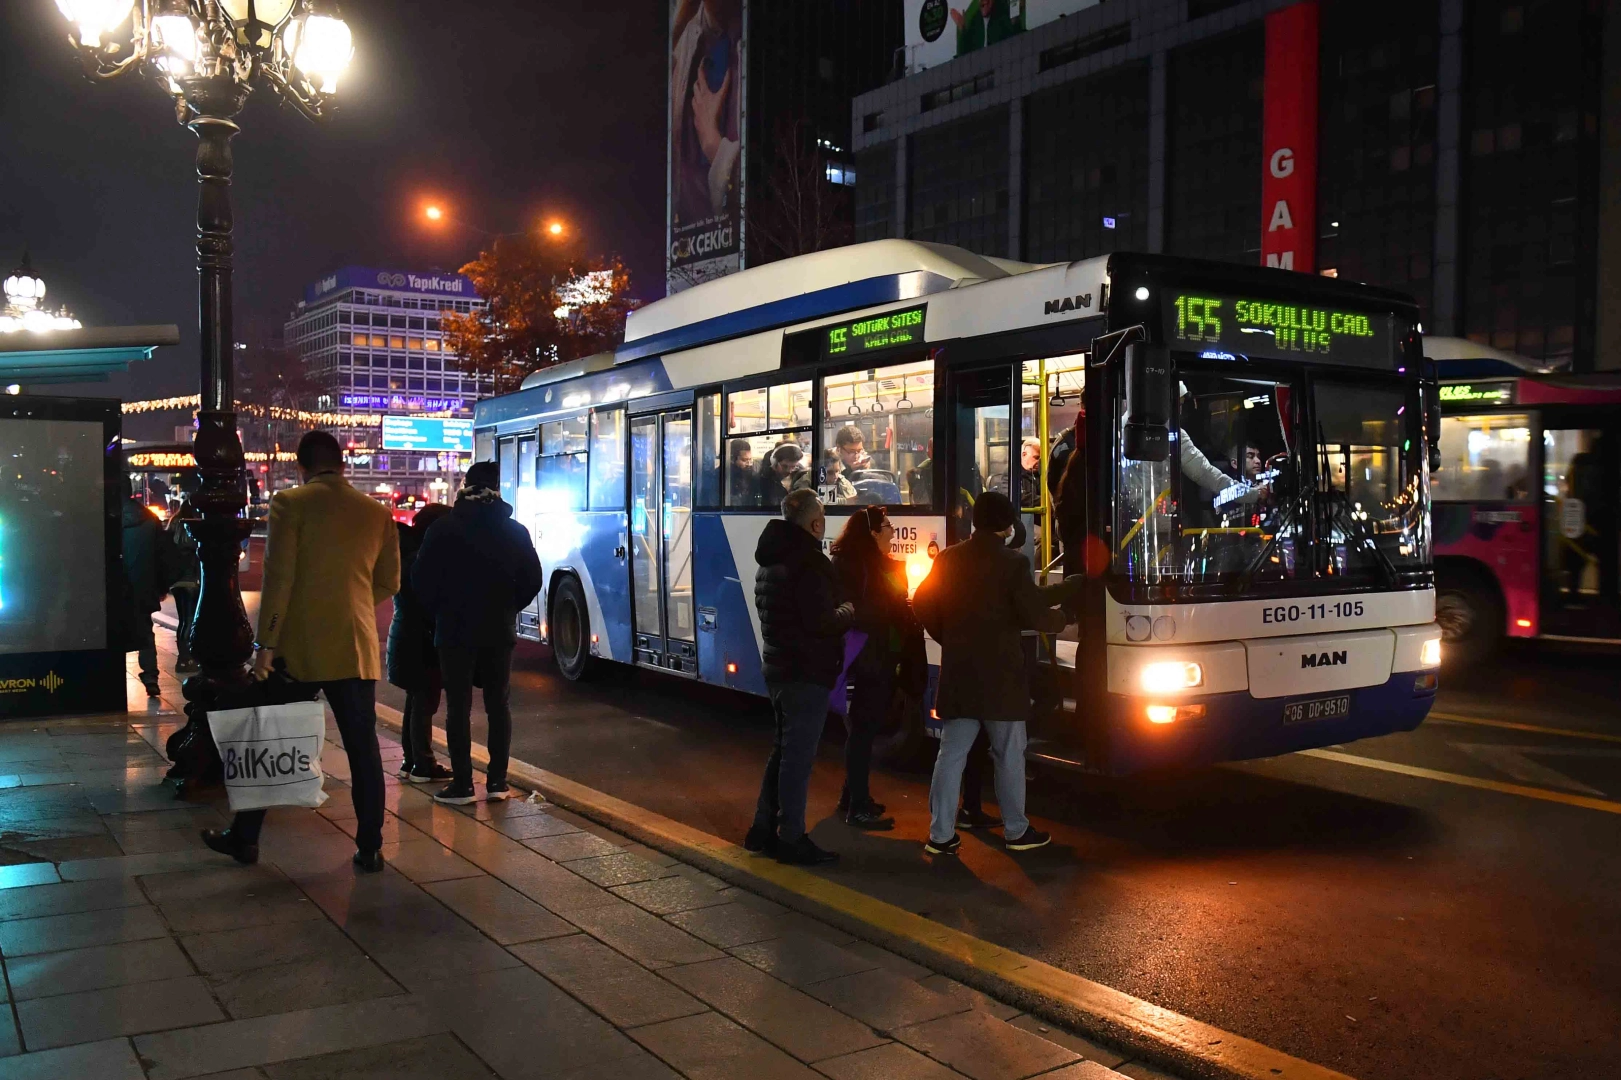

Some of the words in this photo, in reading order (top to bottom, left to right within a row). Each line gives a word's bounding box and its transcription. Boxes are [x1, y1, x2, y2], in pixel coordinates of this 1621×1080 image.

[408, 274, 463, 292] YapıKredi
[1044, 293, 1091, 315] MAN
[1174, 295, 1222, 343] 155
[1235, 300, 1325, 331] SOKULLU
[1331, 312, 1374, 337] CAD.
[1274, 328, 1331, 354] ULUS
[1262, 601, 1364, 624] EGO-11-105
[1301, 650, 1348, 669] MAN
[1291, 704, 1303, 721] 06
[1324, 698, 1348, 716] 9510
[225, 746, 310, 780] BilKid's
